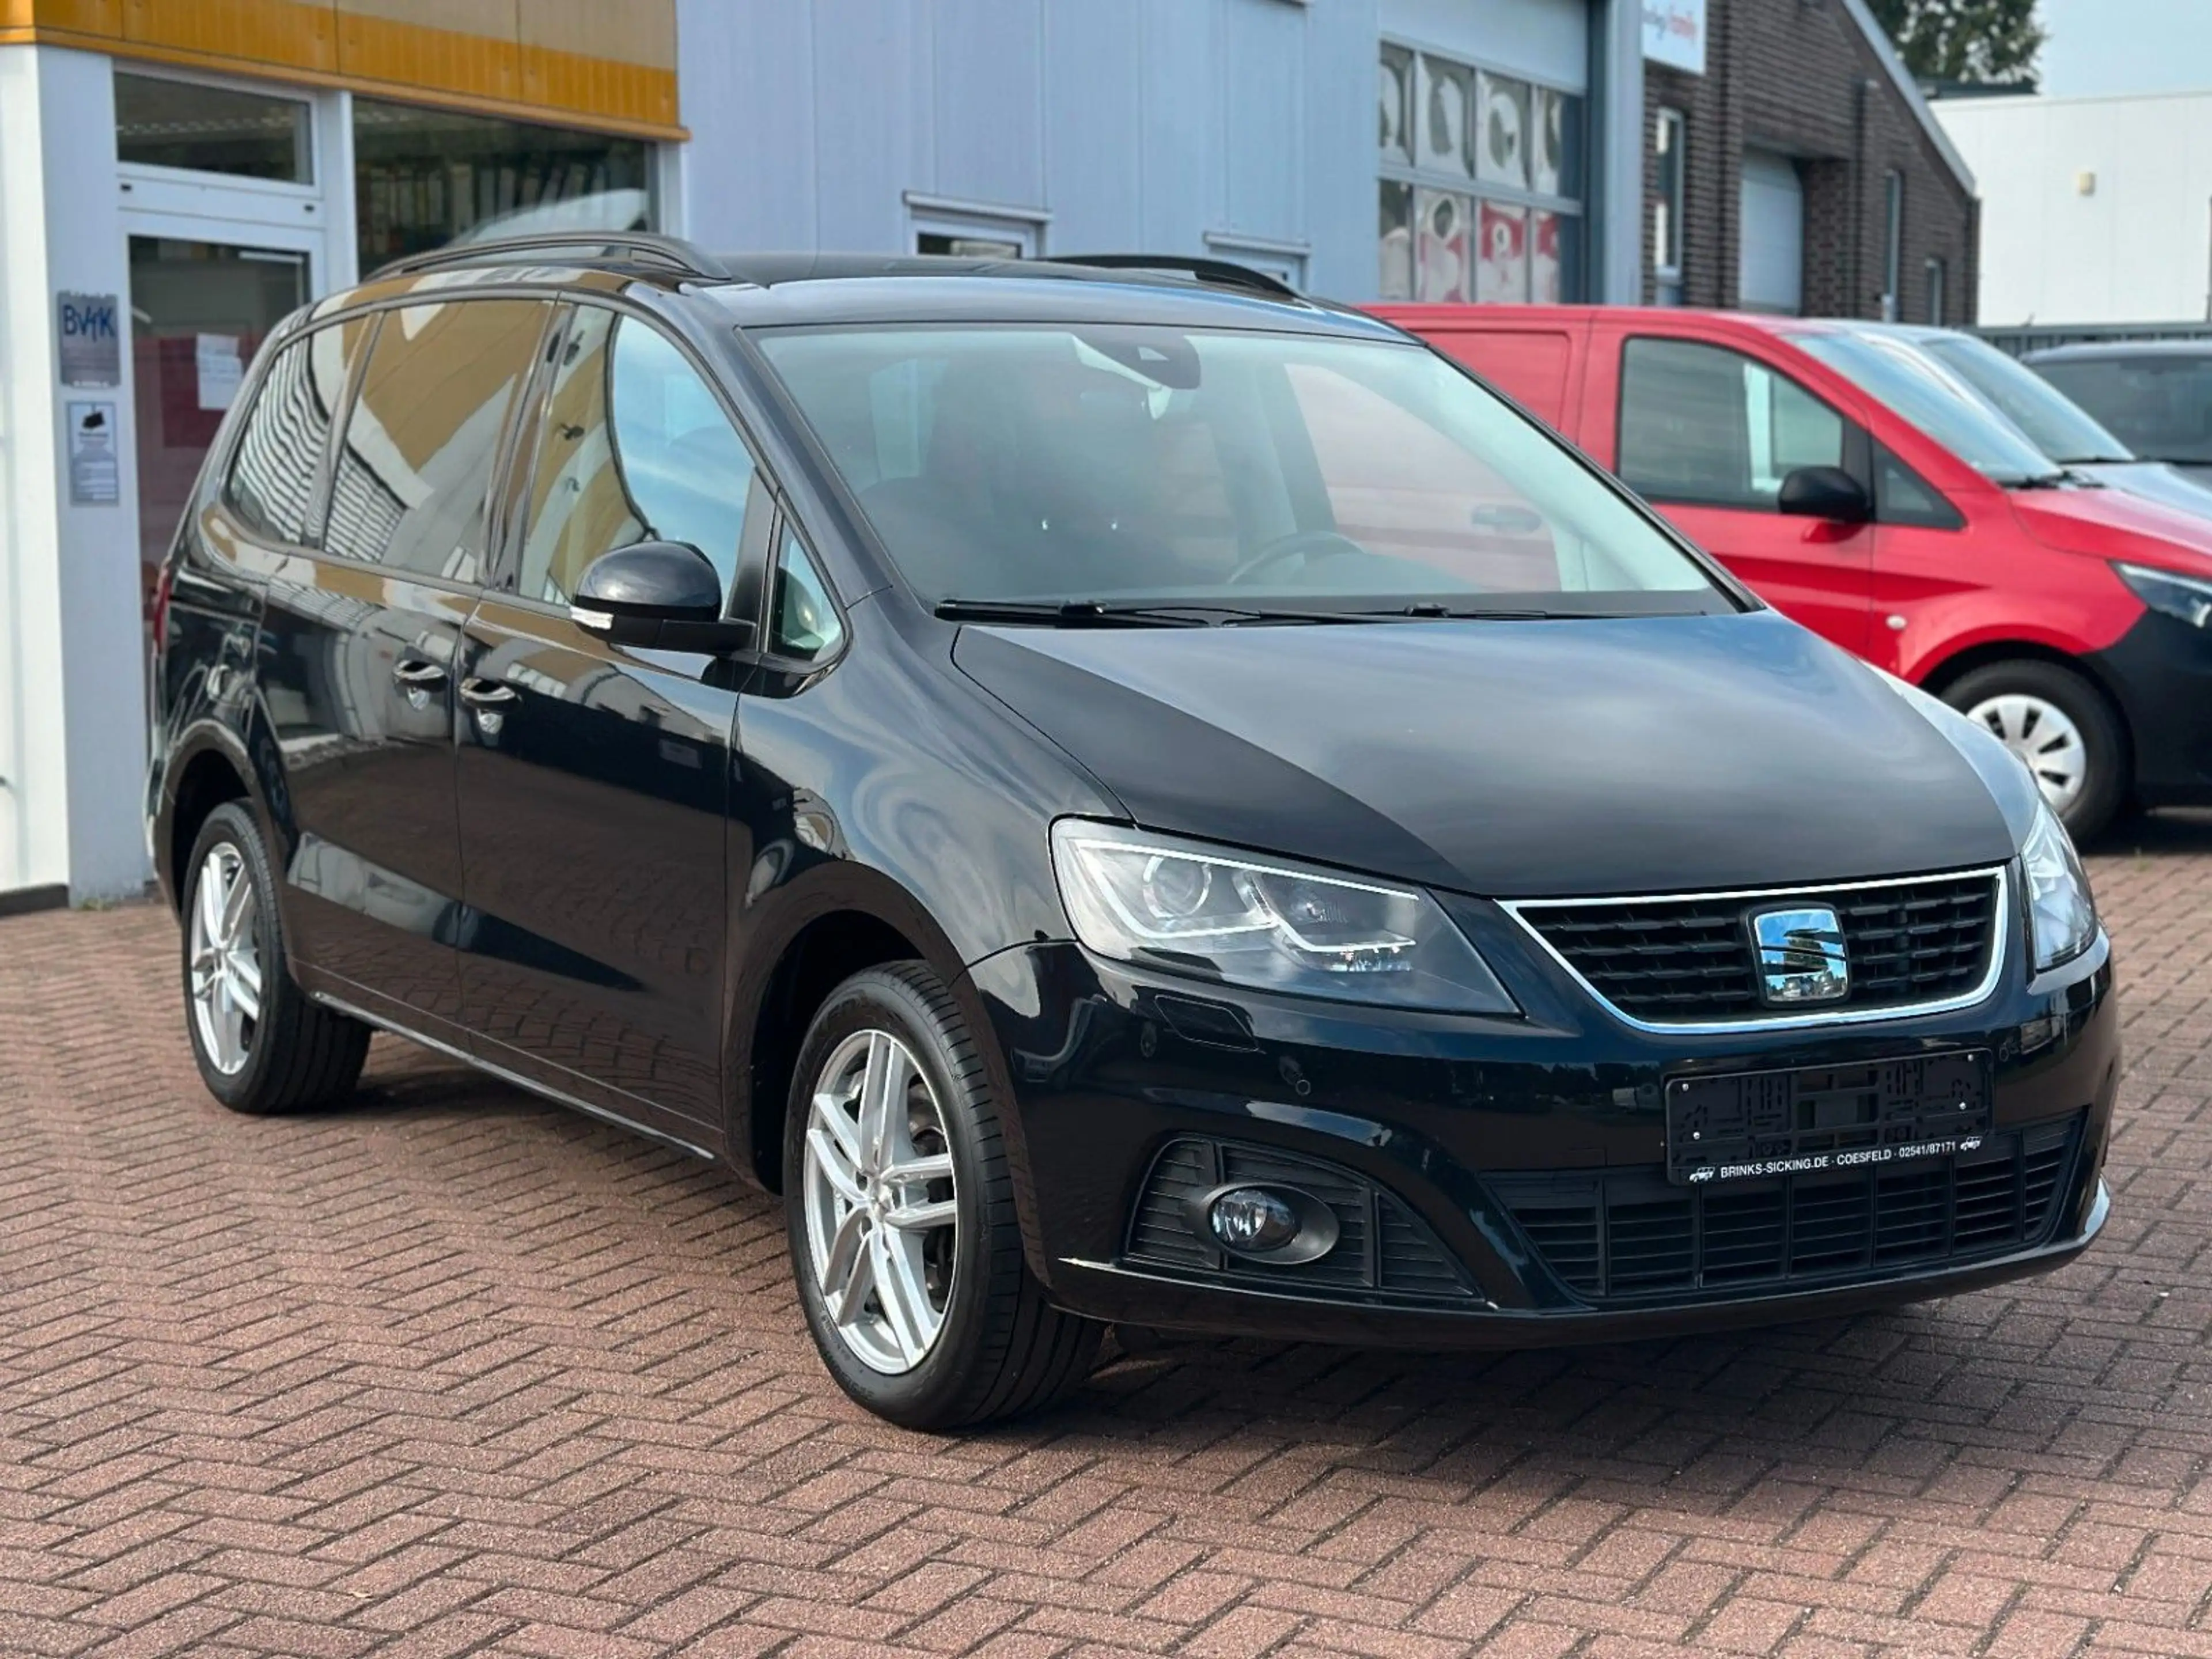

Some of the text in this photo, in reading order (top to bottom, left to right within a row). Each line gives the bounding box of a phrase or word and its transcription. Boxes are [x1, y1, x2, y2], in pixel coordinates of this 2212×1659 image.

[1721, 1141, 1956, 1179] BRINKS-SICKING.DE COESFELD 02541/87171
